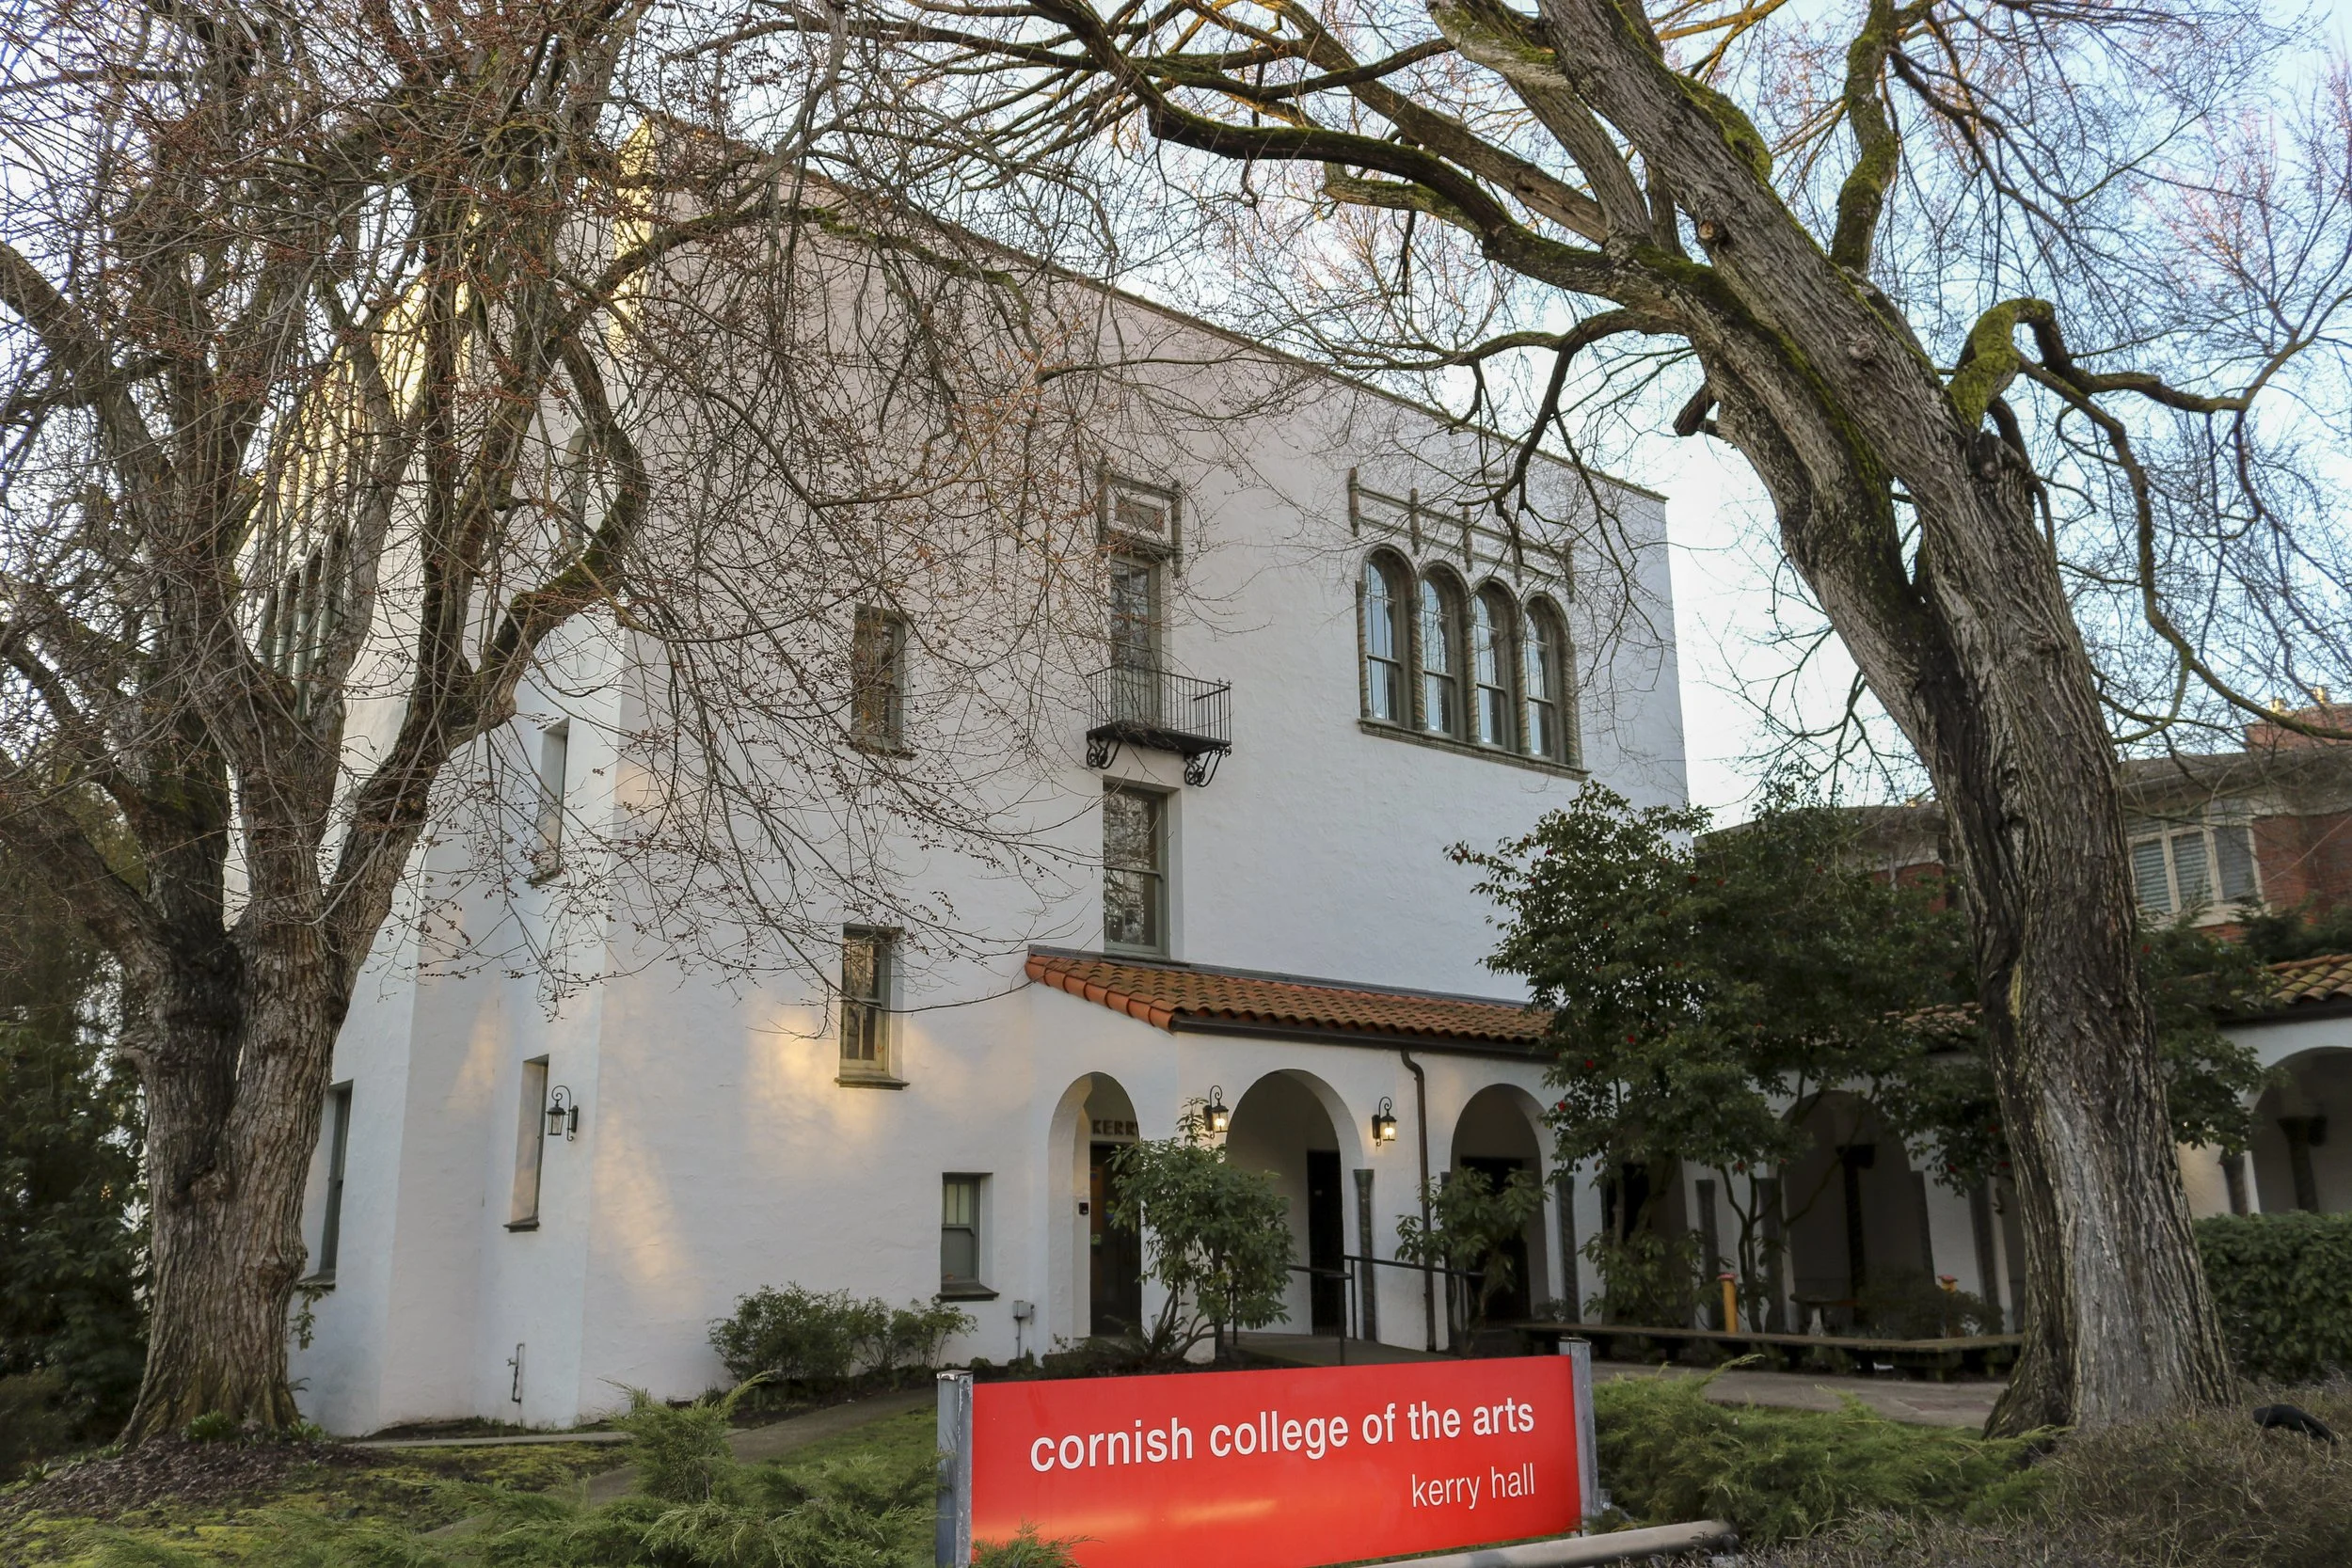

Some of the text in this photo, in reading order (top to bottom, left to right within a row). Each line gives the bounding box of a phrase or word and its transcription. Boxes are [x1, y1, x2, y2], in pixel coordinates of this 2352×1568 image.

[1092, 1119, 1137, 1135] KERR
[1030, 1397, 1534, 1472] cornish college of the arts
[1411, 1463, 1535, 1510] kerry hall
